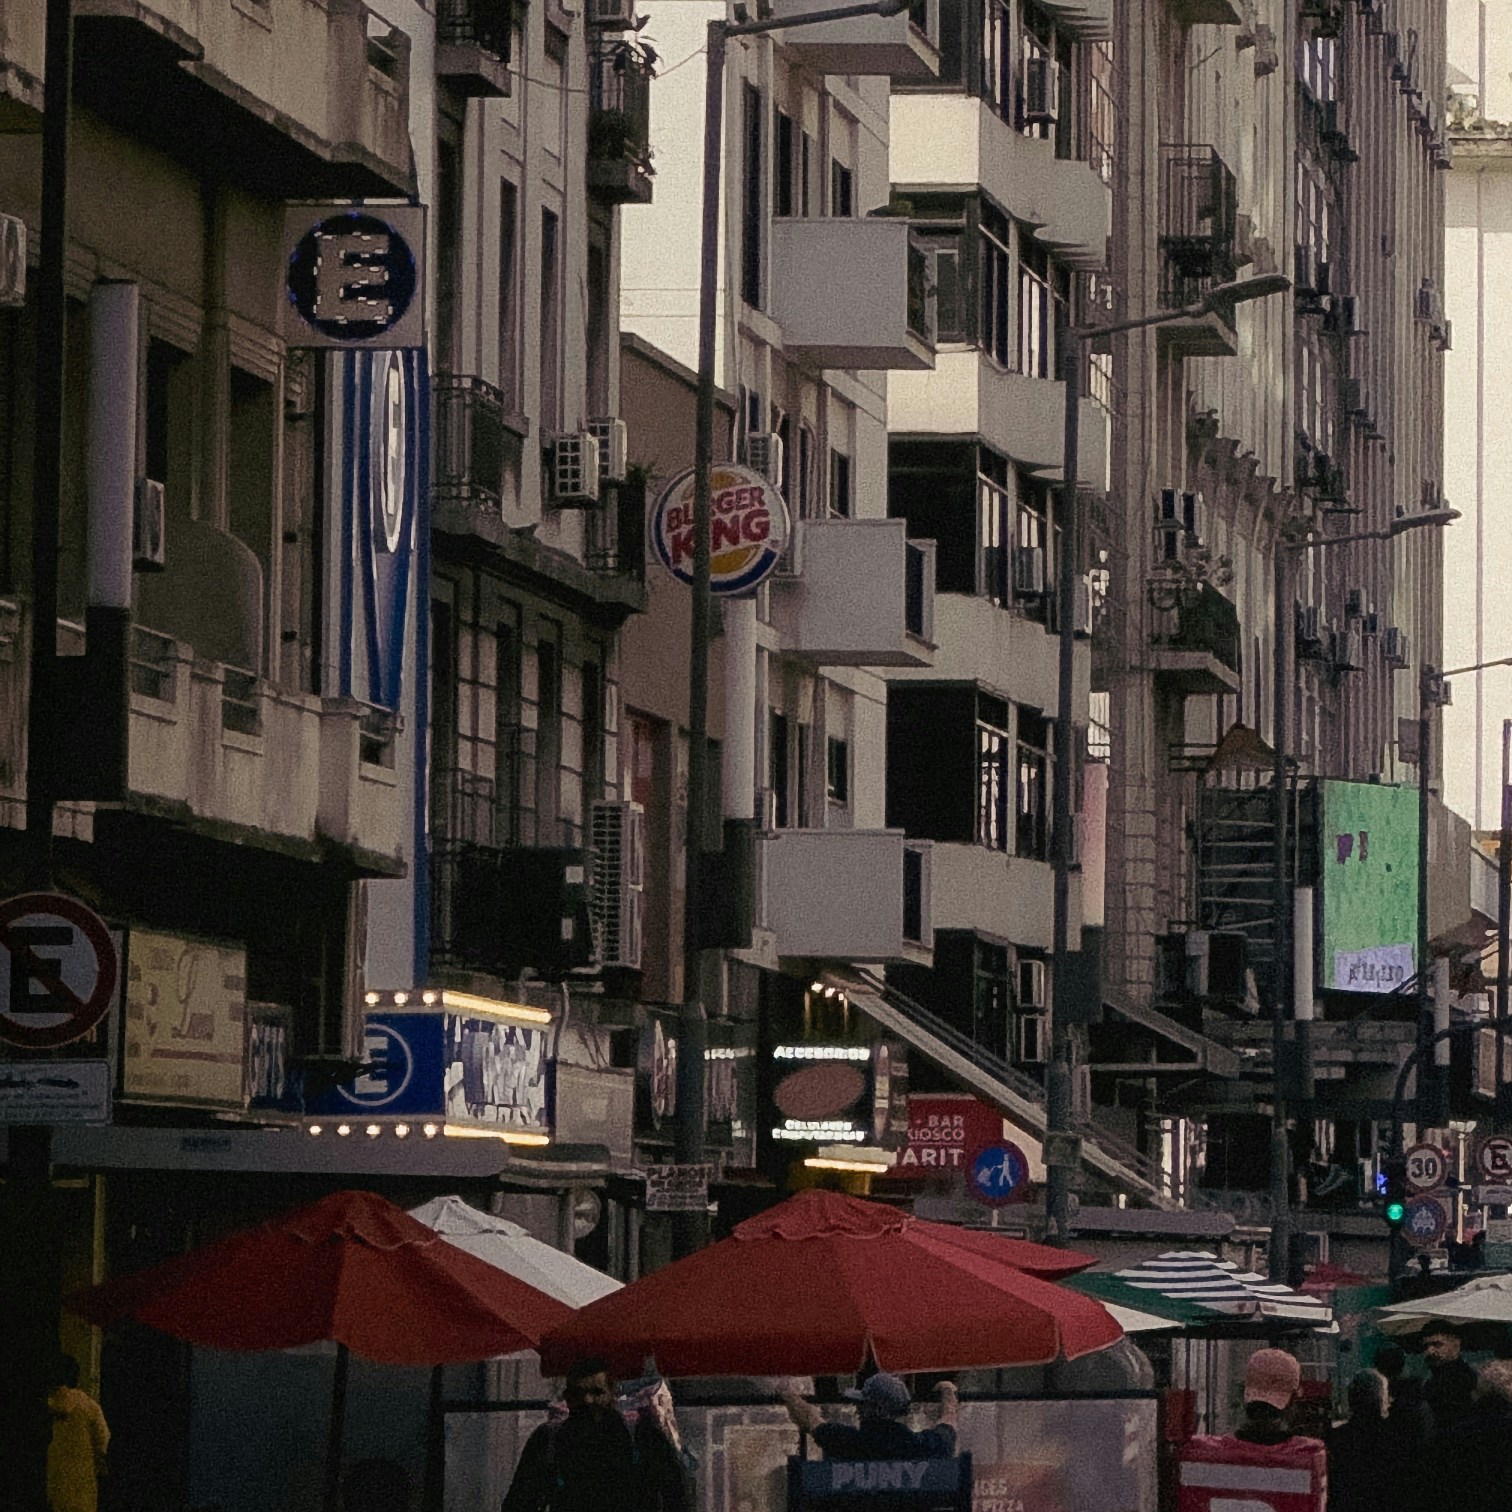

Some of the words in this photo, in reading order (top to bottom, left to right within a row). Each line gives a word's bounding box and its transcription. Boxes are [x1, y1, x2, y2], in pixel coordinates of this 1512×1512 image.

[313, 230, 393, 325] E
[671, 508, 771, 566] KNG
[10, 925, 76, 1014] E
[928, 1115, 965, 1127] BAR
[1410, 1157, 1438, 1179] 30
